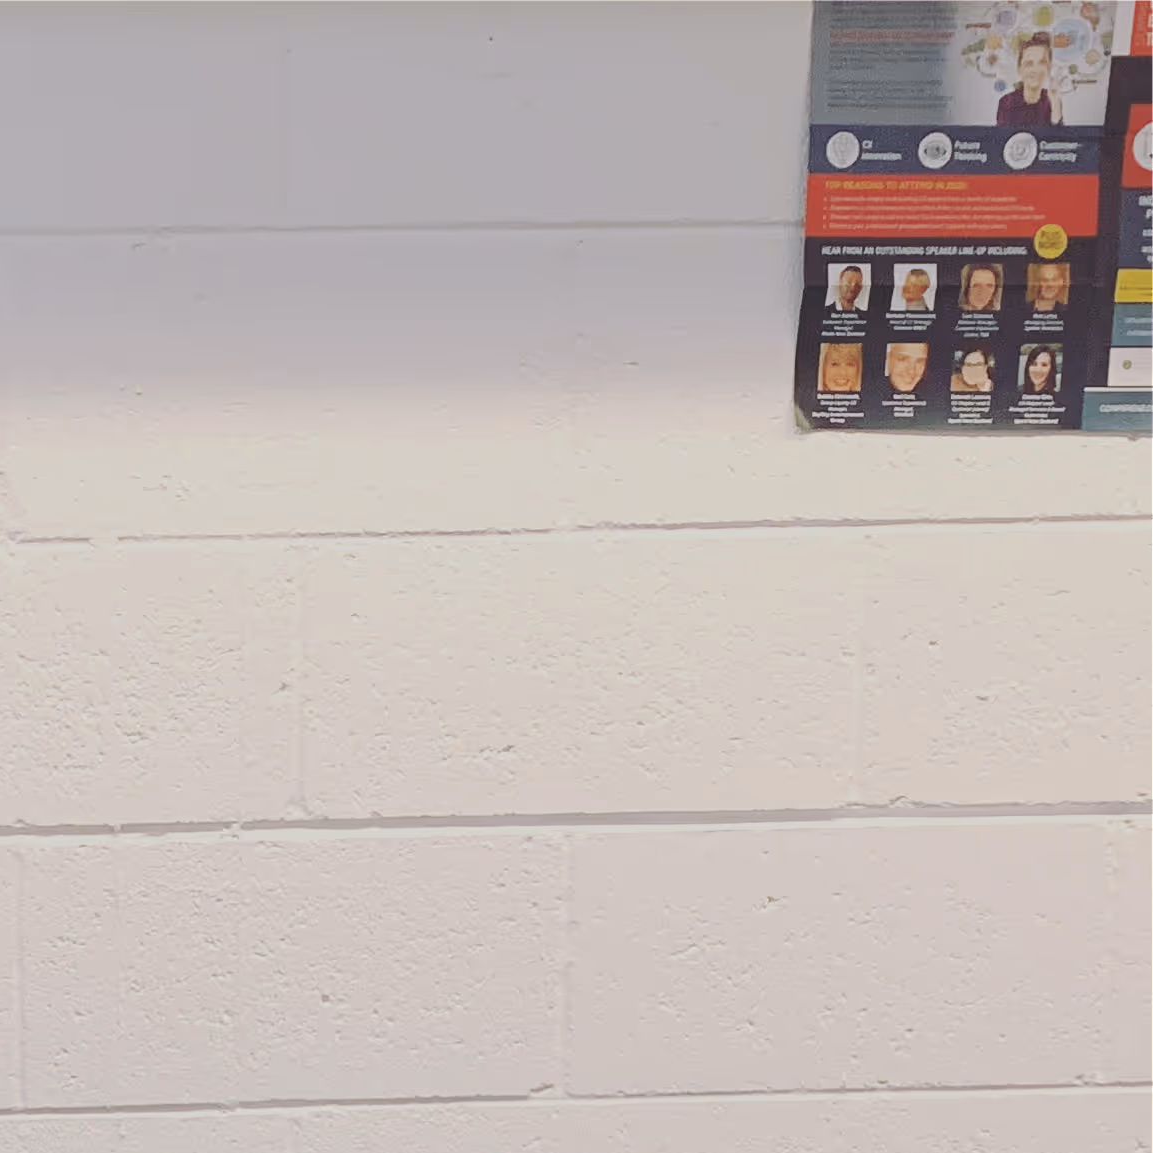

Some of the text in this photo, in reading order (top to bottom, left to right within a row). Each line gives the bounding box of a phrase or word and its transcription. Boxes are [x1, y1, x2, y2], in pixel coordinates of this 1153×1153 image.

[821, 245, 841, 256] HEAR
[842, 245, 863, 256] FROM
[863, 245, 875, 256] AN
[875, 245, 925, 256] OUTSTANDING
[925, 245, 957, 256] SPEAKER
[958, 245, 987, 256] LINE-UP
